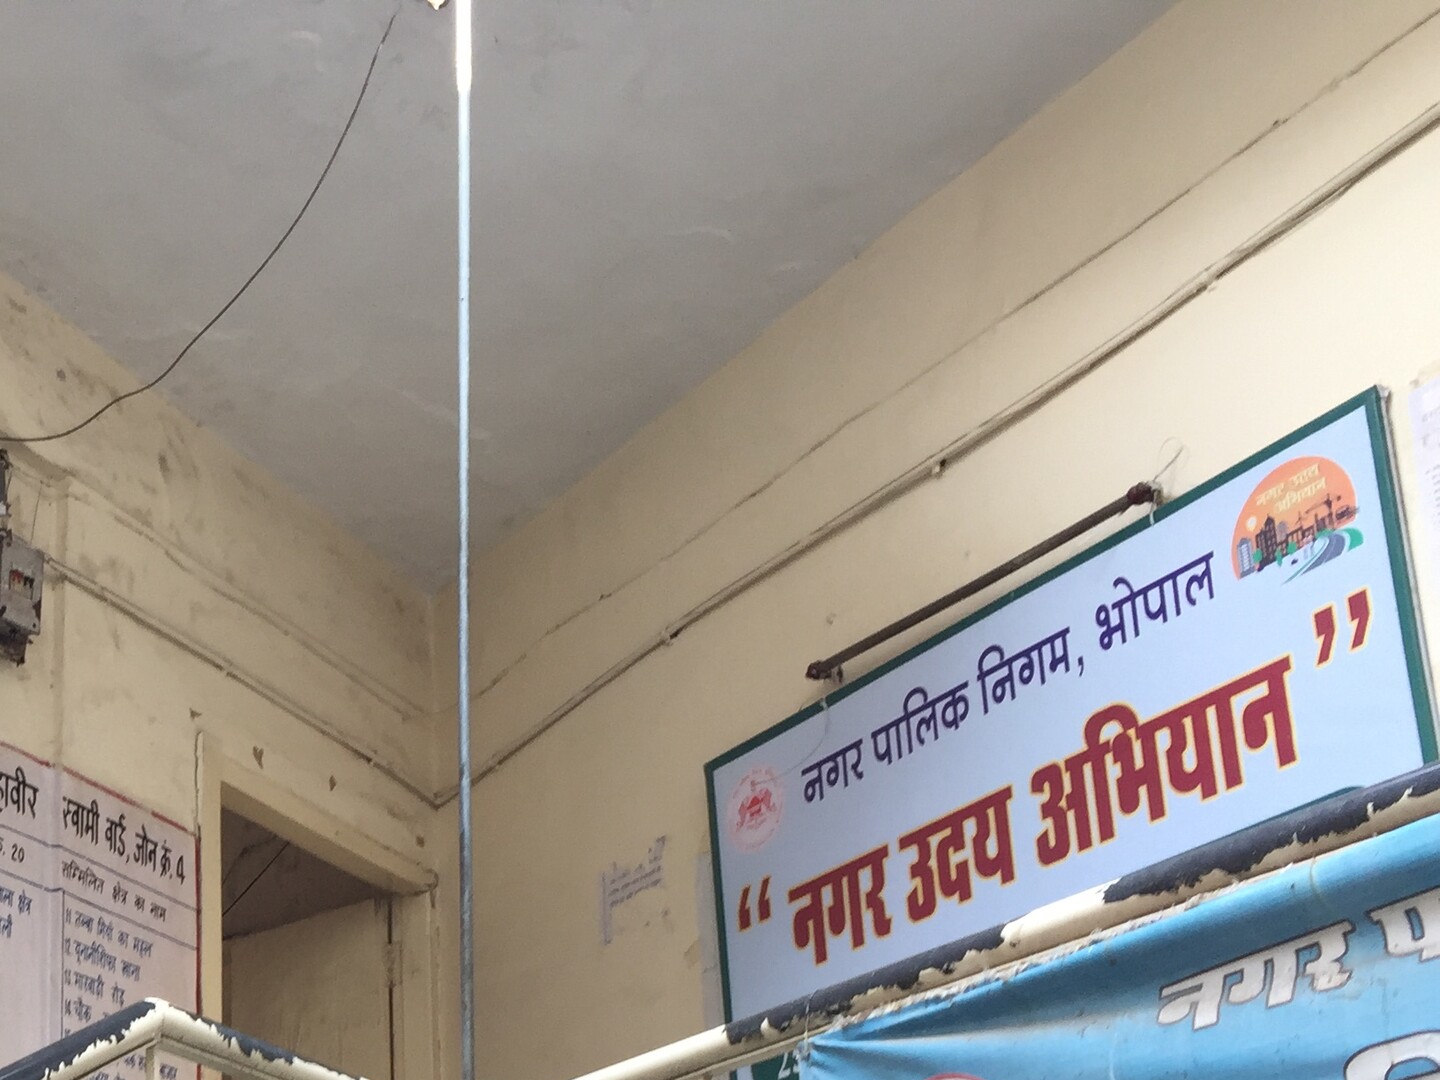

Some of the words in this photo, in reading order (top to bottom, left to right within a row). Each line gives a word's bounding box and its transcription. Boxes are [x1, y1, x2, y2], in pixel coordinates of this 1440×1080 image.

[801, 738, 865, 803] नगर
[871, 681, 969, 766] पालिक
[978, 626, 1084, 716] निगम,
[1095, 549, 1215, 651] भोपाल
[11, 843, 25, 863] 20
[62, 796, 100, 846] स्वामी
[105, 813, 130, 864] वार्ड,
[132, 824, 158, 872] जोन
[175, 854, 186, 885] 4
[899, 784, 1017, 924] उदय
[1156, 919, 1356, 1033] नगर
[1365, 886, 1440, 963] प
